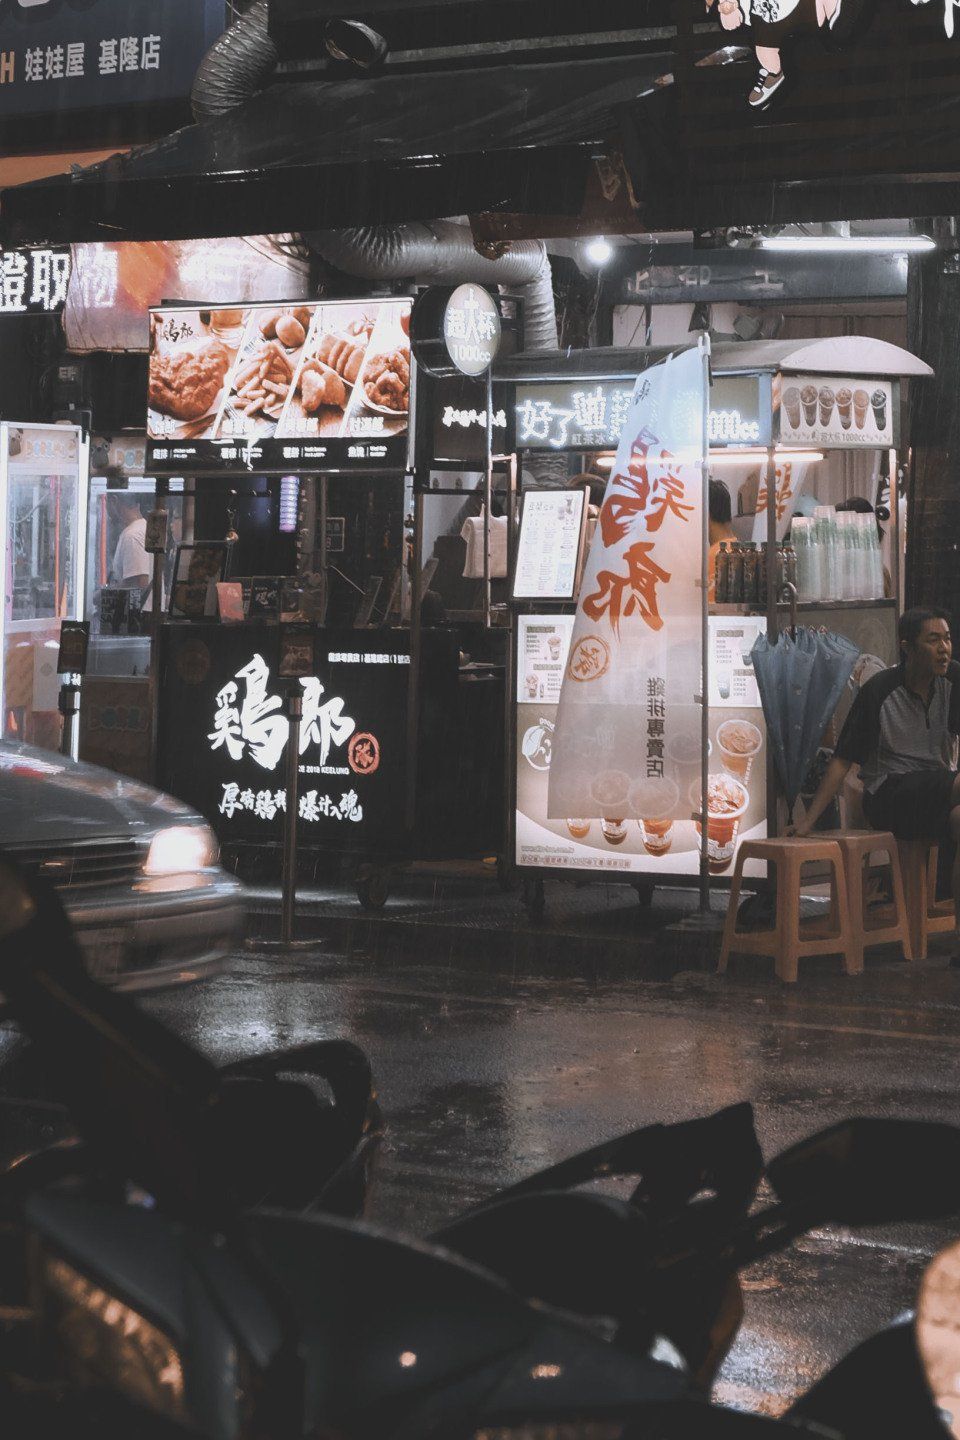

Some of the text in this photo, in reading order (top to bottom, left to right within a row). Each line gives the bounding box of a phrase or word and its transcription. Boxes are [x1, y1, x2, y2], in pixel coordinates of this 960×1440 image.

[25, 42, 85, 82] 娃娃屋
[98, 34, 161, 75] 基隆店
[453, 344, 491, 362] 1000cc
